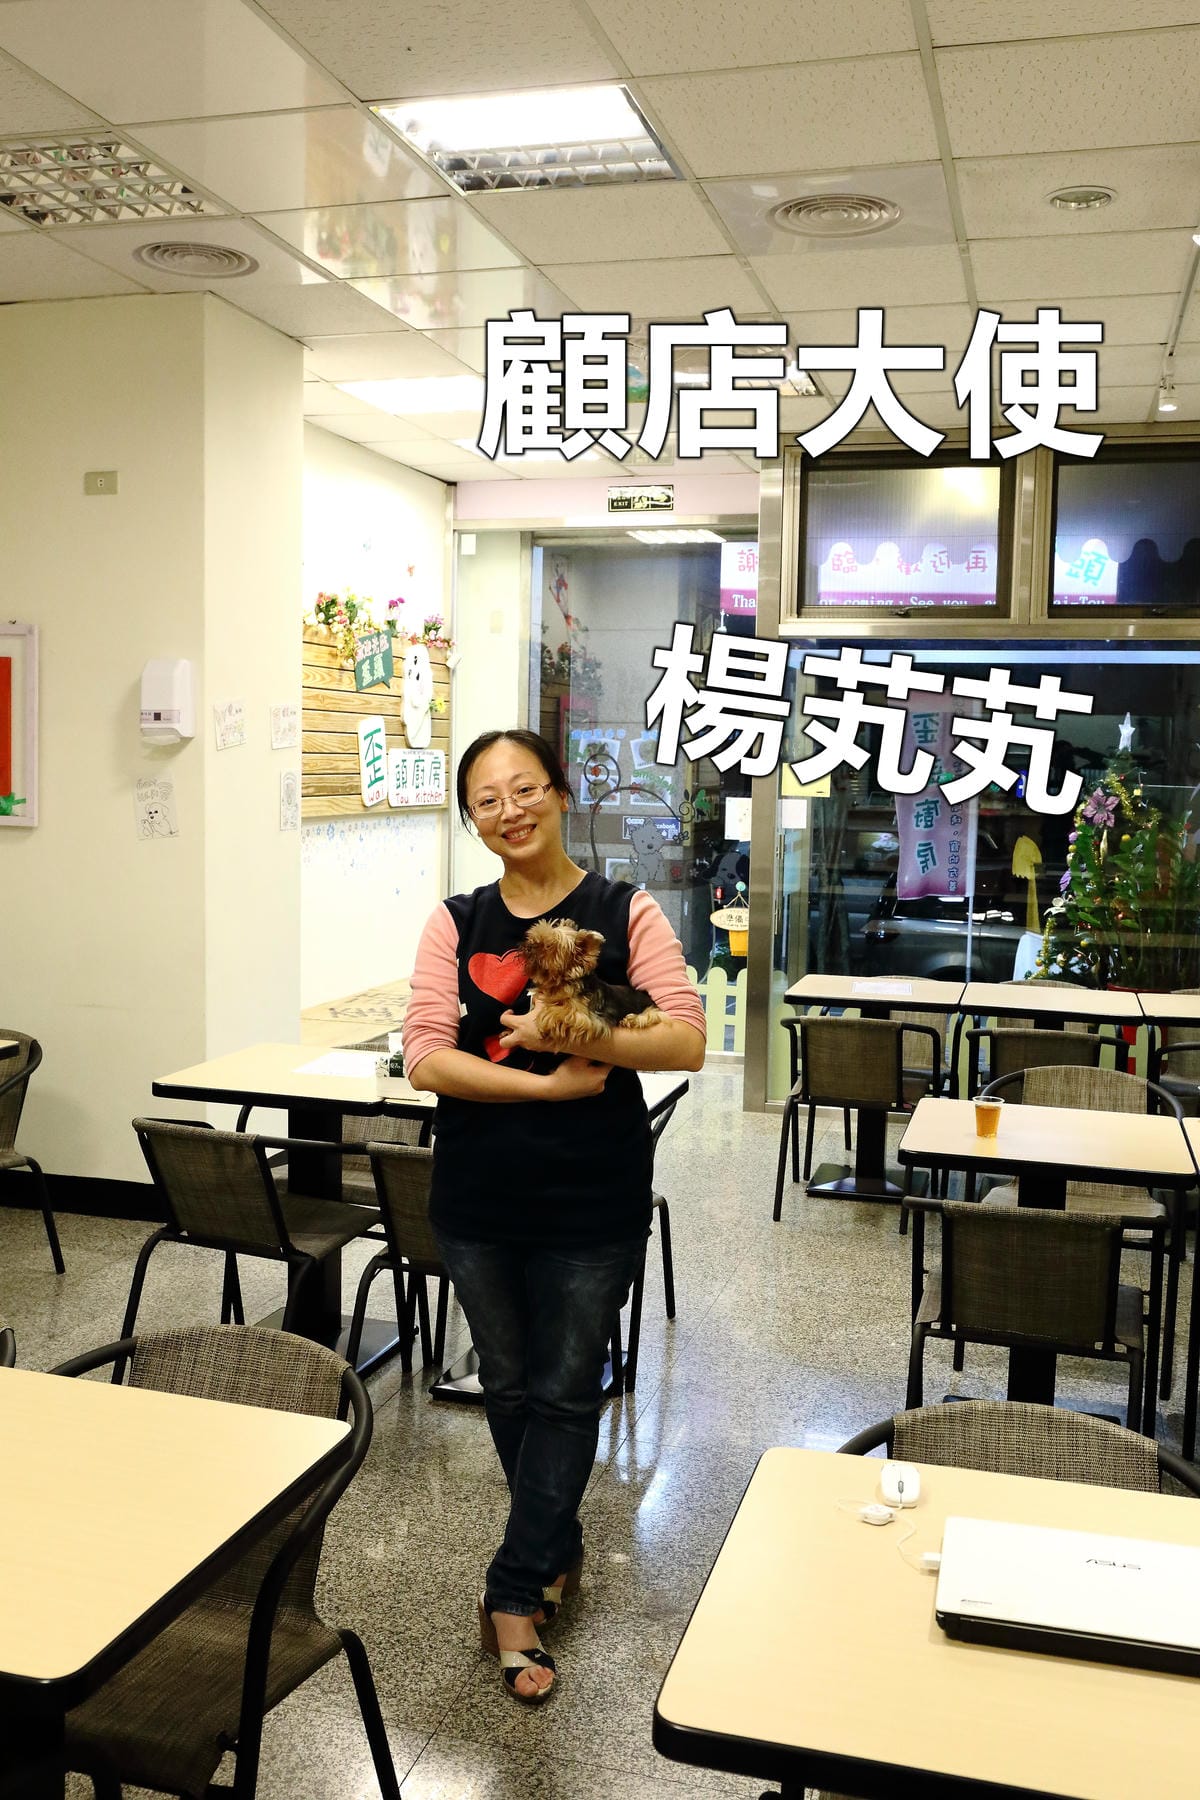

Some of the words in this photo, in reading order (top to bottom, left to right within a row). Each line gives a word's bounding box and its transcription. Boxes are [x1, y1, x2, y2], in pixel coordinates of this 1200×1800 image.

[363, 727, 385, 789] 歪
[395, 755, 442, 790] 頭廚房
[1086, 1558, 1142, 1570] ASUS
